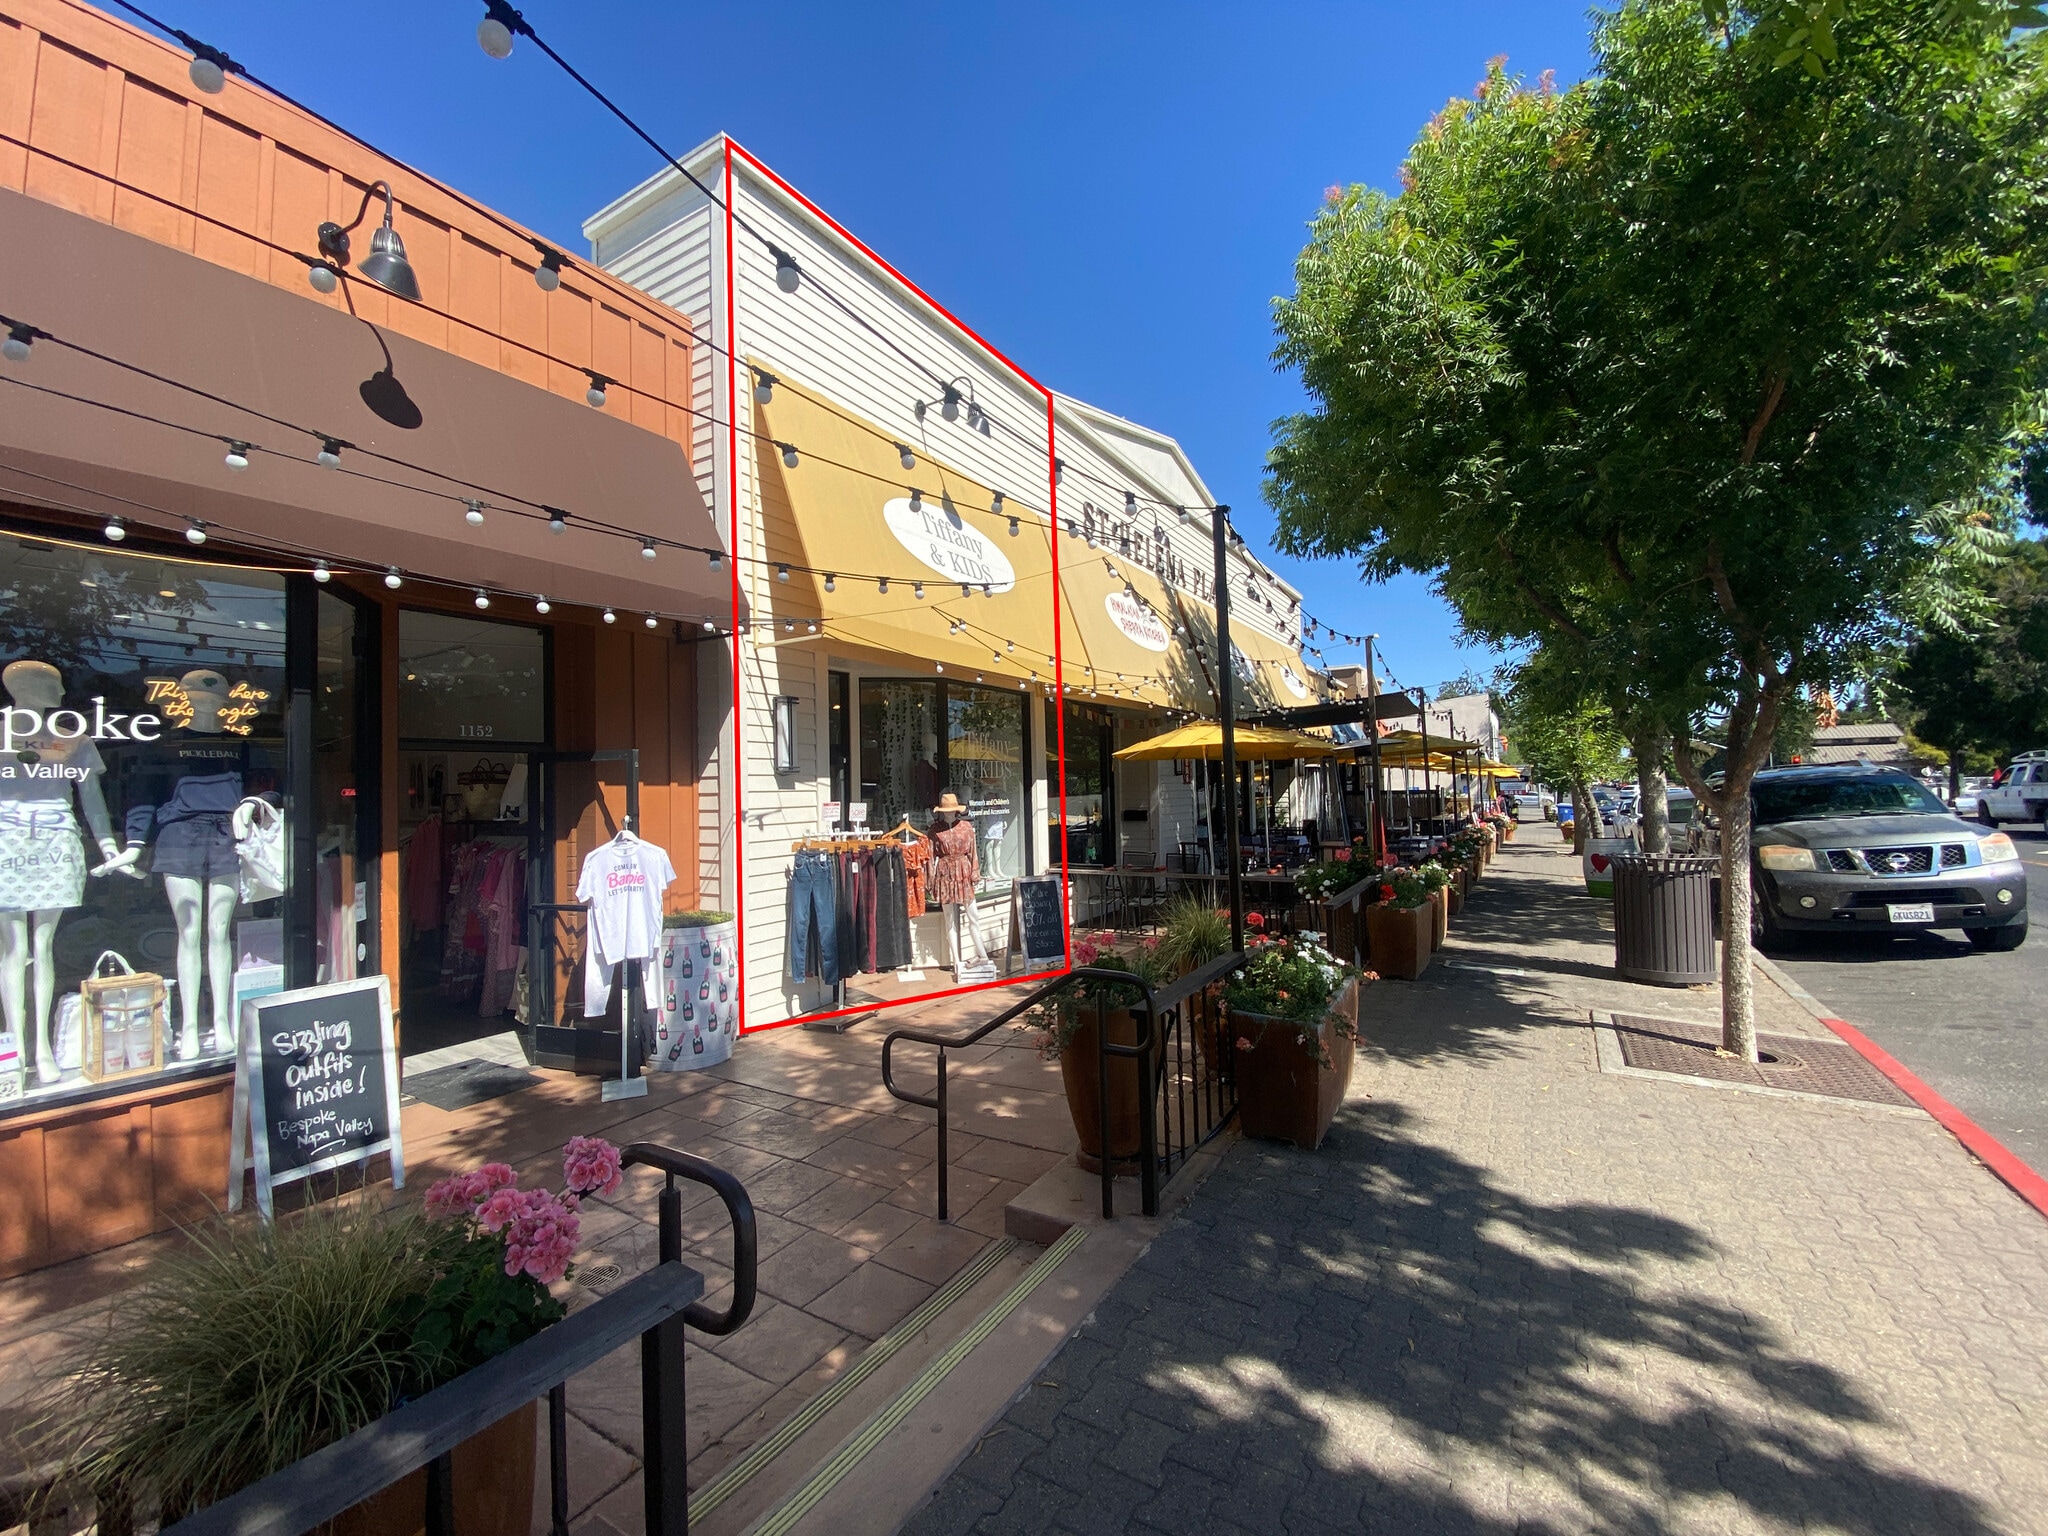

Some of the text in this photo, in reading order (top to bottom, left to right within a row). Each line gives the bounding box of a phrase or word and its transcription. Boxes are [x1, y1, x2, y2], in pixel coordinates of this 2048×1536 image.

[921, 510, 983, 560] Tiffany
[930, 543, 994, 583] & KIDS
[228, 683, 269, 700] here
[0, 696, 161, 753] poke
[460, 725, 493, 737] 1152
[964, 731, 1011, 756] Tiffany
[23, 763, 91, 782] Valley
[964, 761, 1012, 779] & KIDS
[272, 1020, 351, 1060] Sizzling
[285, 1051, 353, 1088] Outfits
[278, 1109, 337, 1140] Bespoke
[297, 1117, 373, 1149] Napa Valley
